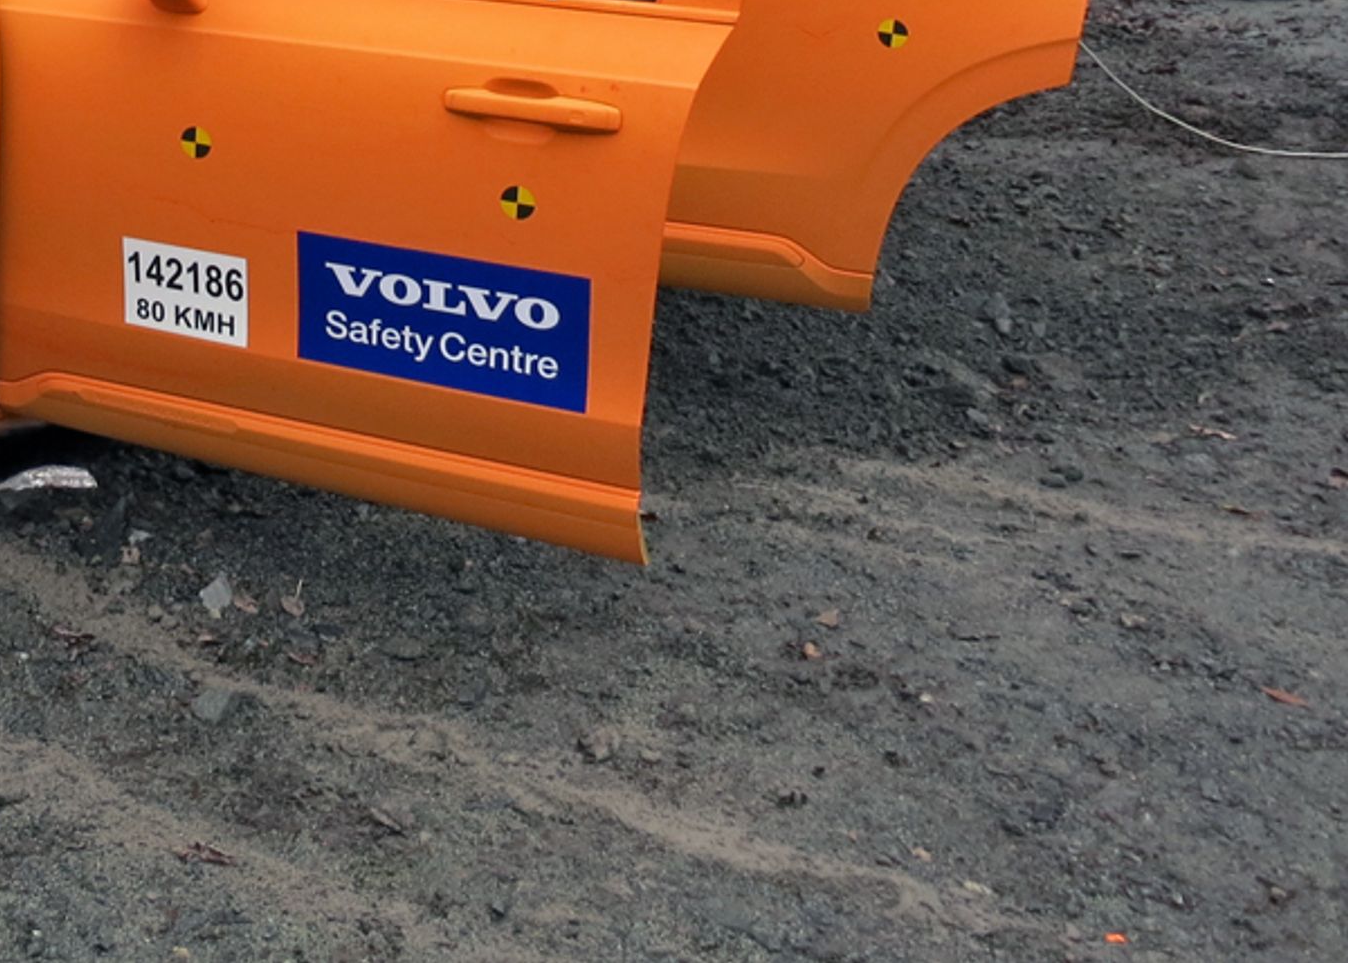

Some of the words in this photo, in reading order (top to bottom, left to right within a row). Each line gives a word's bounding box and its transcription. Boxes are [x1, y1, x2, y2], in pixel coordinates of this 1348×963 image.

[128, 251, 244, 302] 142186
[325, 262, 560, 330] VOLVO
[136, 298, 165, 322] 80
[174, 304, 235, 336] KMH
[325, 310, 434, 362] Safety
[439, 332, 559, 379] Centre
